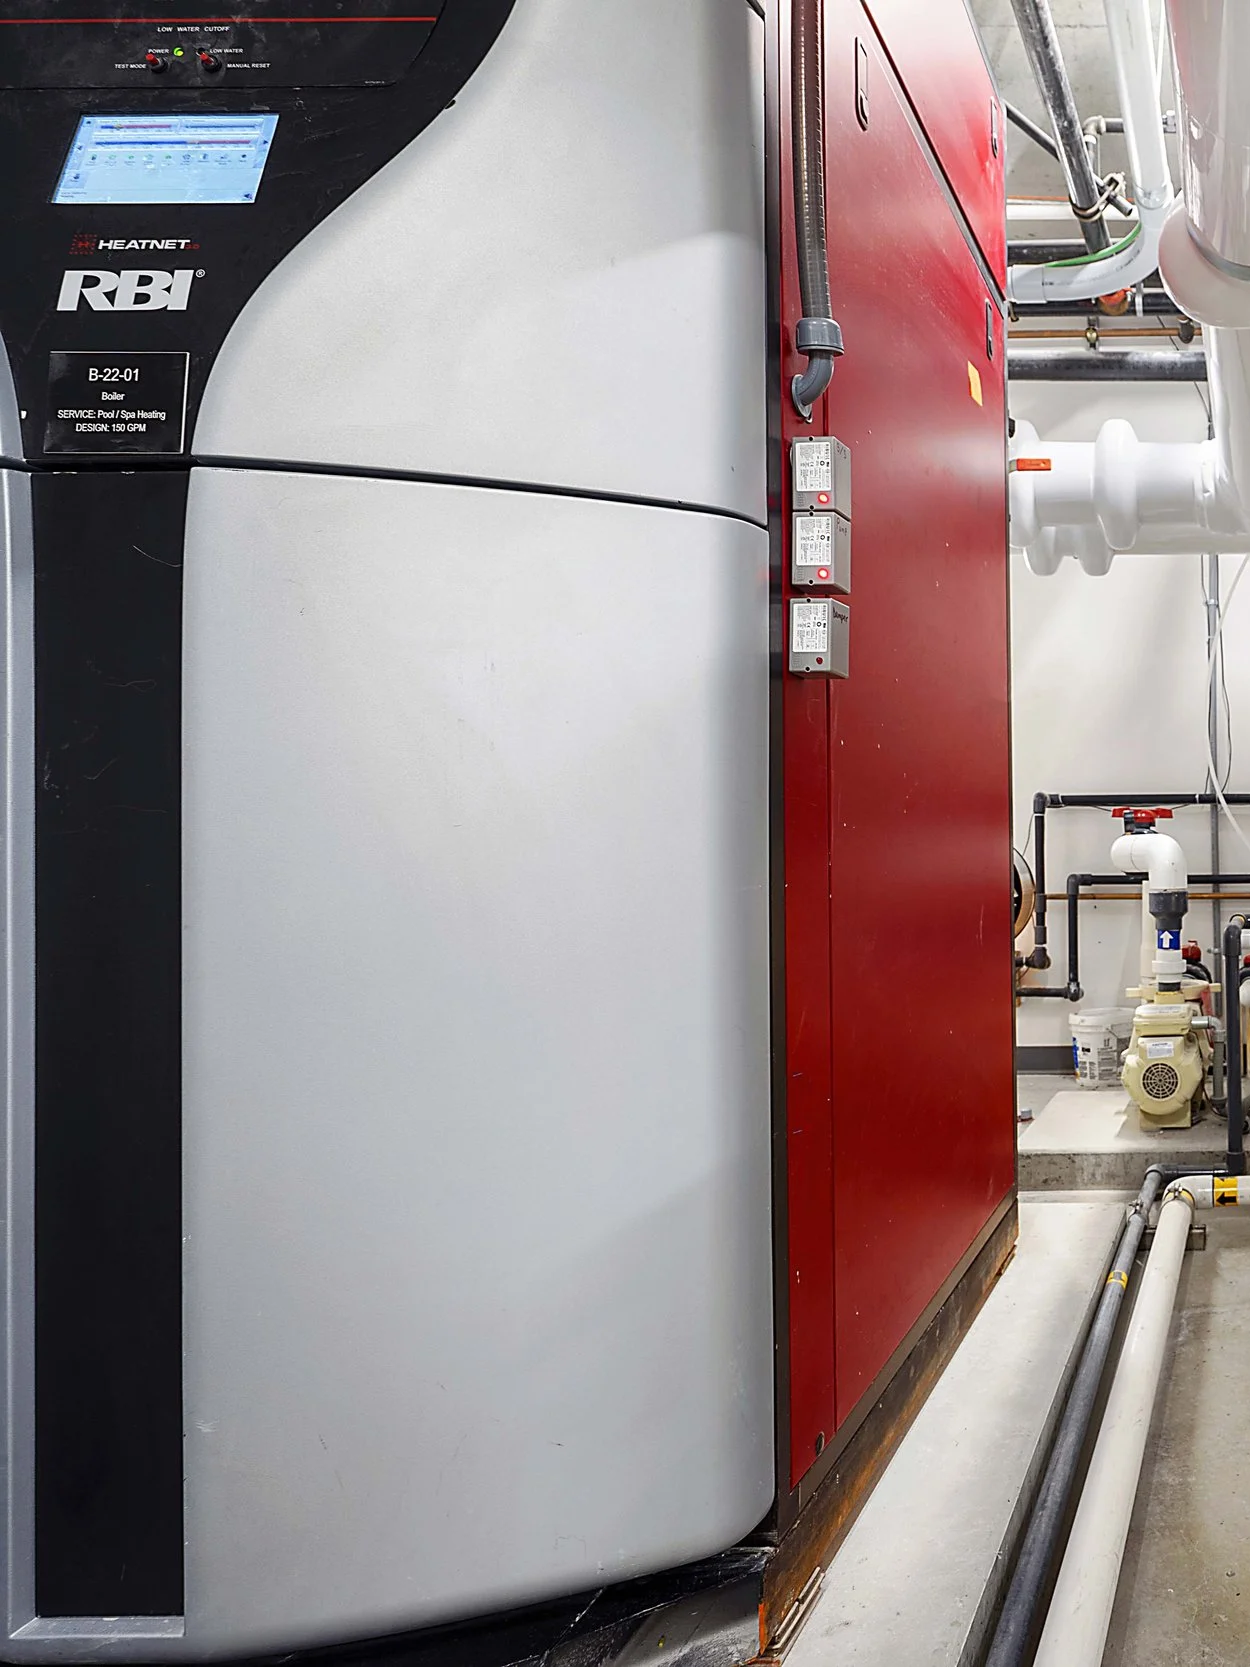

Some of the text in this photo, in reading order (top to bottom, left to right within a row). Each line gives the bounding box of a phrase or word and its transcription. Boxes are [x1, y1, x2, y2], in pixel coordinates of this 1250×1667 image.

[98, 239, 190, 250] HEATNET
[88, 367, 140, 382] B-22-01
[101, 391, 125, 401] Boiler
[57, 409, 96, 419] SERVICE:
[97, 409, 115, 419] Pool
[120, 409, 135, 421] Spa
[137, 409, 166, 421] Heating
[75, 423, 147, 432] DESIGN: 150 GPM
